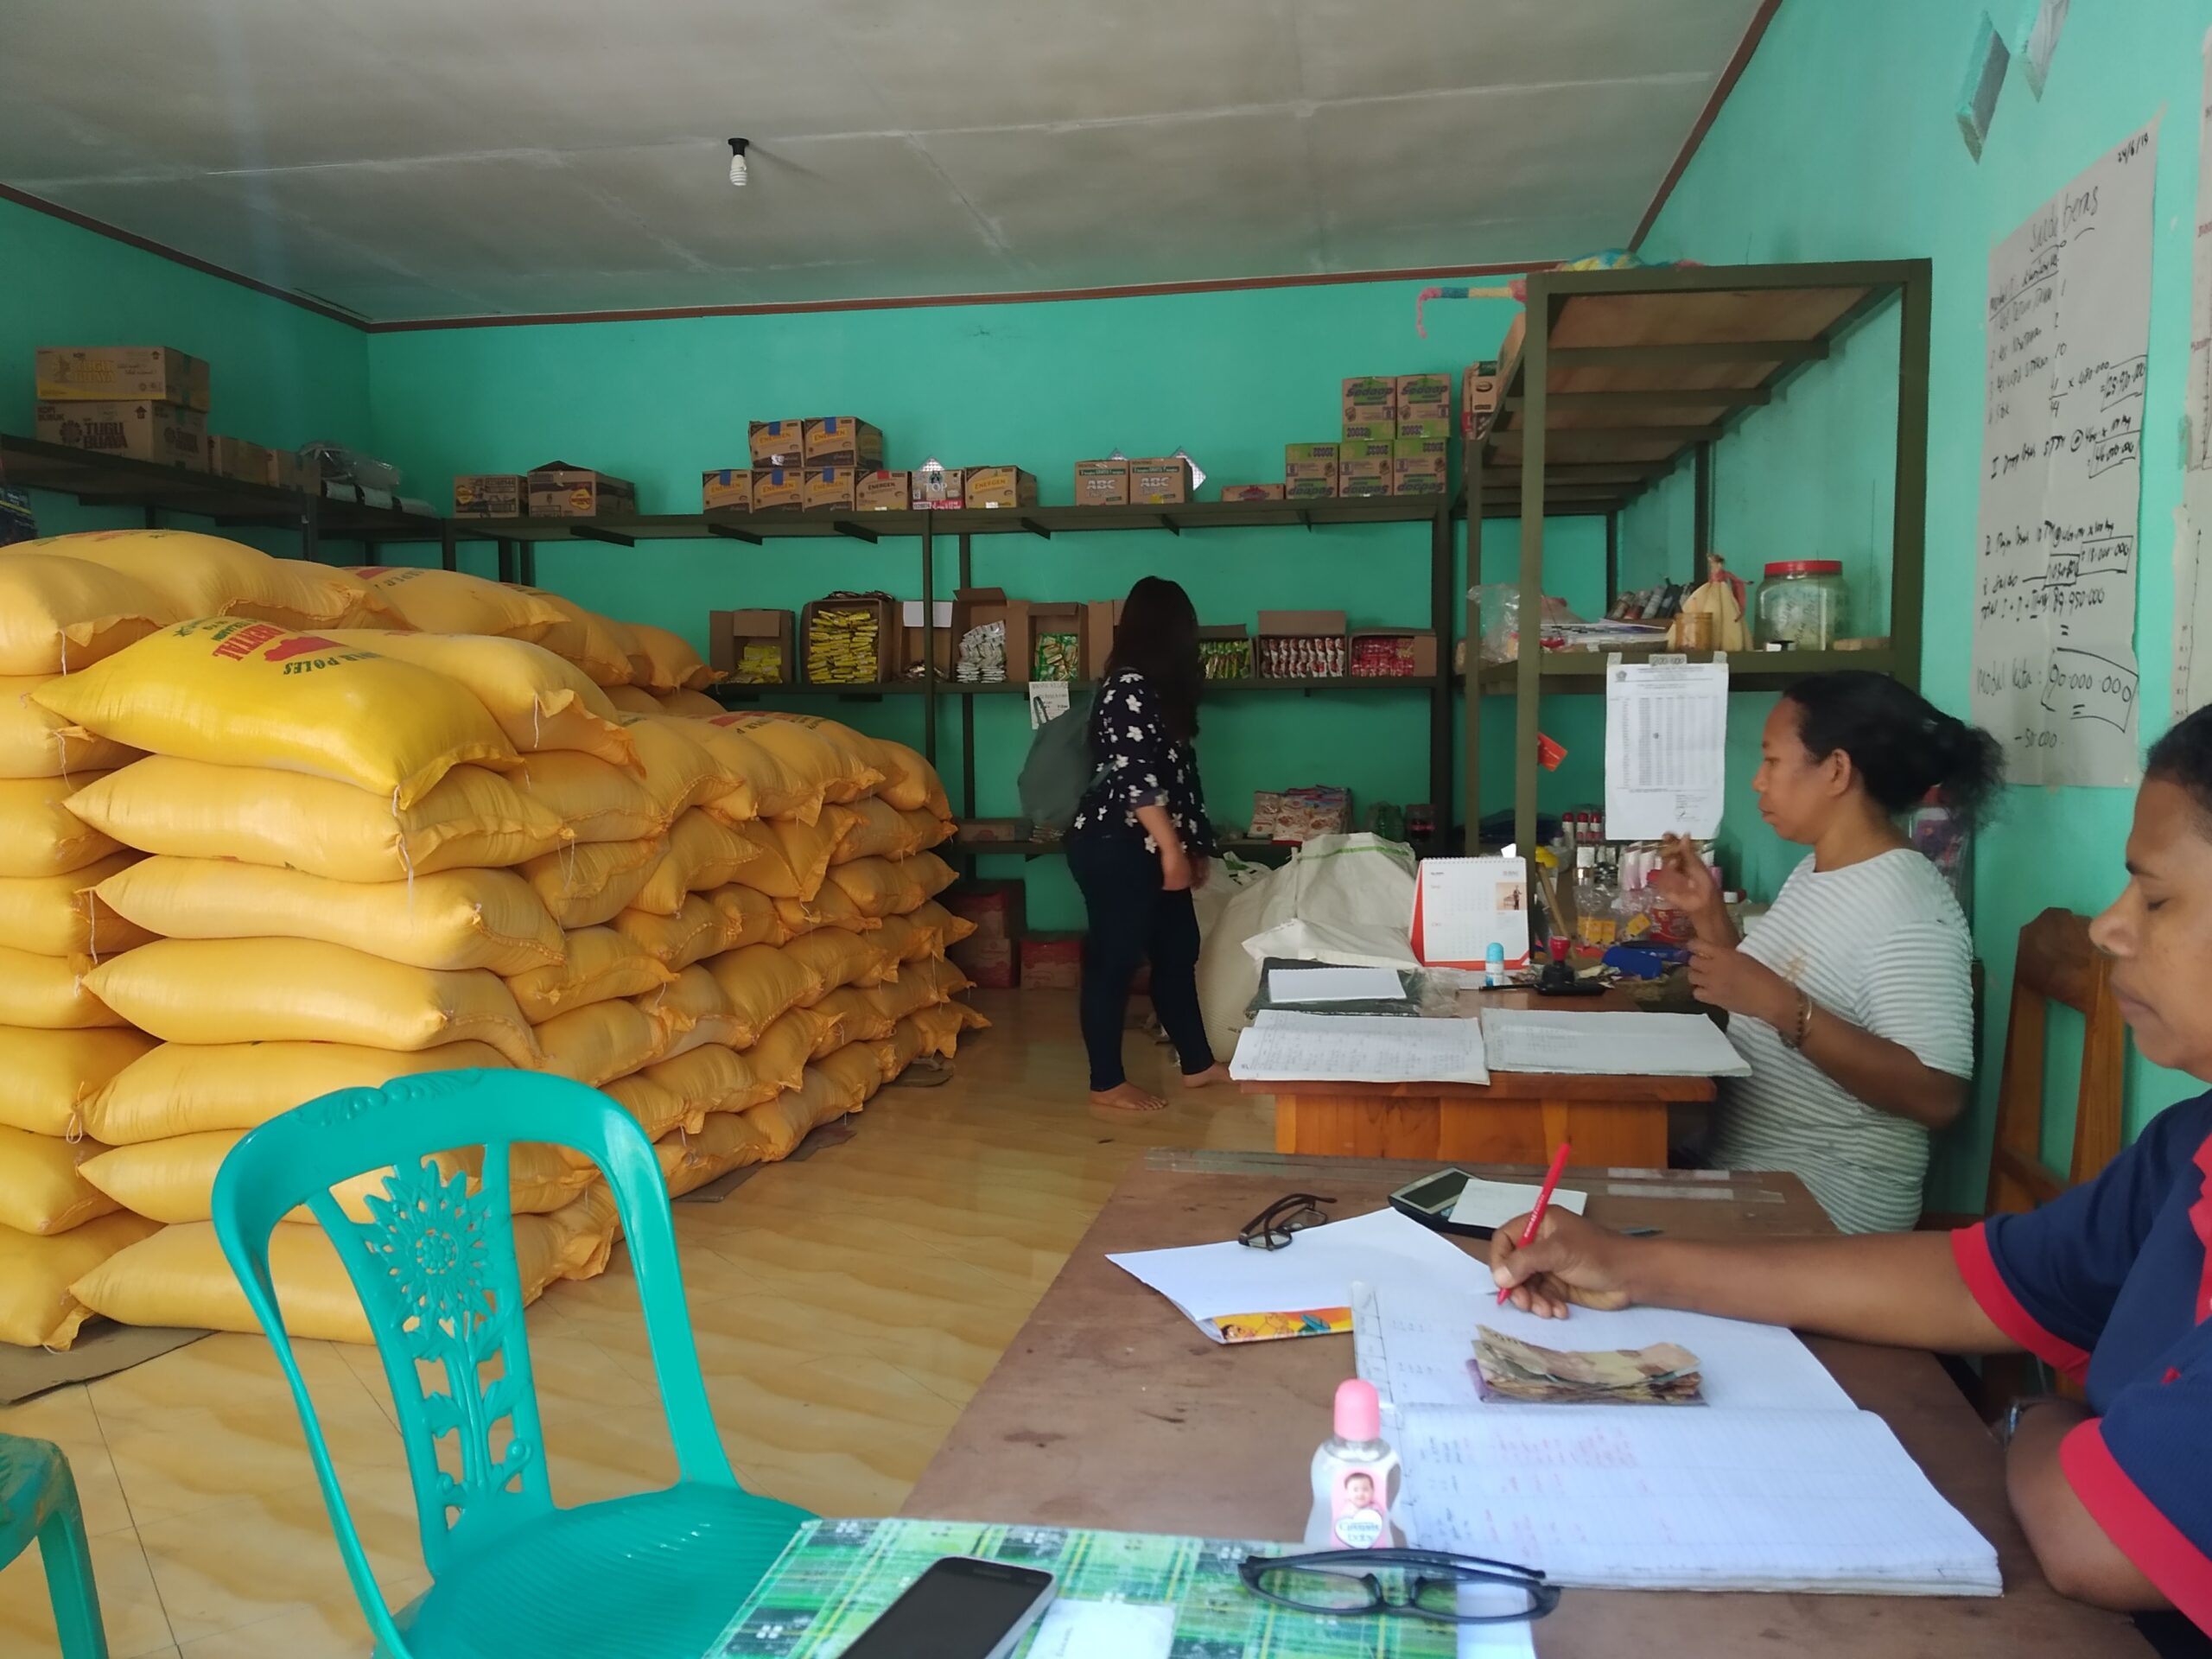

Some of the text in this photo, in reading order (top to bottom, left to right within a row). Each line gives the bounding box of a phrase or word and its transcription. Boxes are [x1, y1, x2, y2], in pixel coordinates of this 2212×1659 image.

[84, 421, 125, 435] TUGU
[868, 481, 897, 491] ENERGEN
[924, 481, 948, 493] TOP
[973, 479, 1007, 490] ENERGEN
[1086, 479, 1116, 490] ABC
[1140, 476, 1170, 487] ABC
[283, 656, 340, 676] POLES
